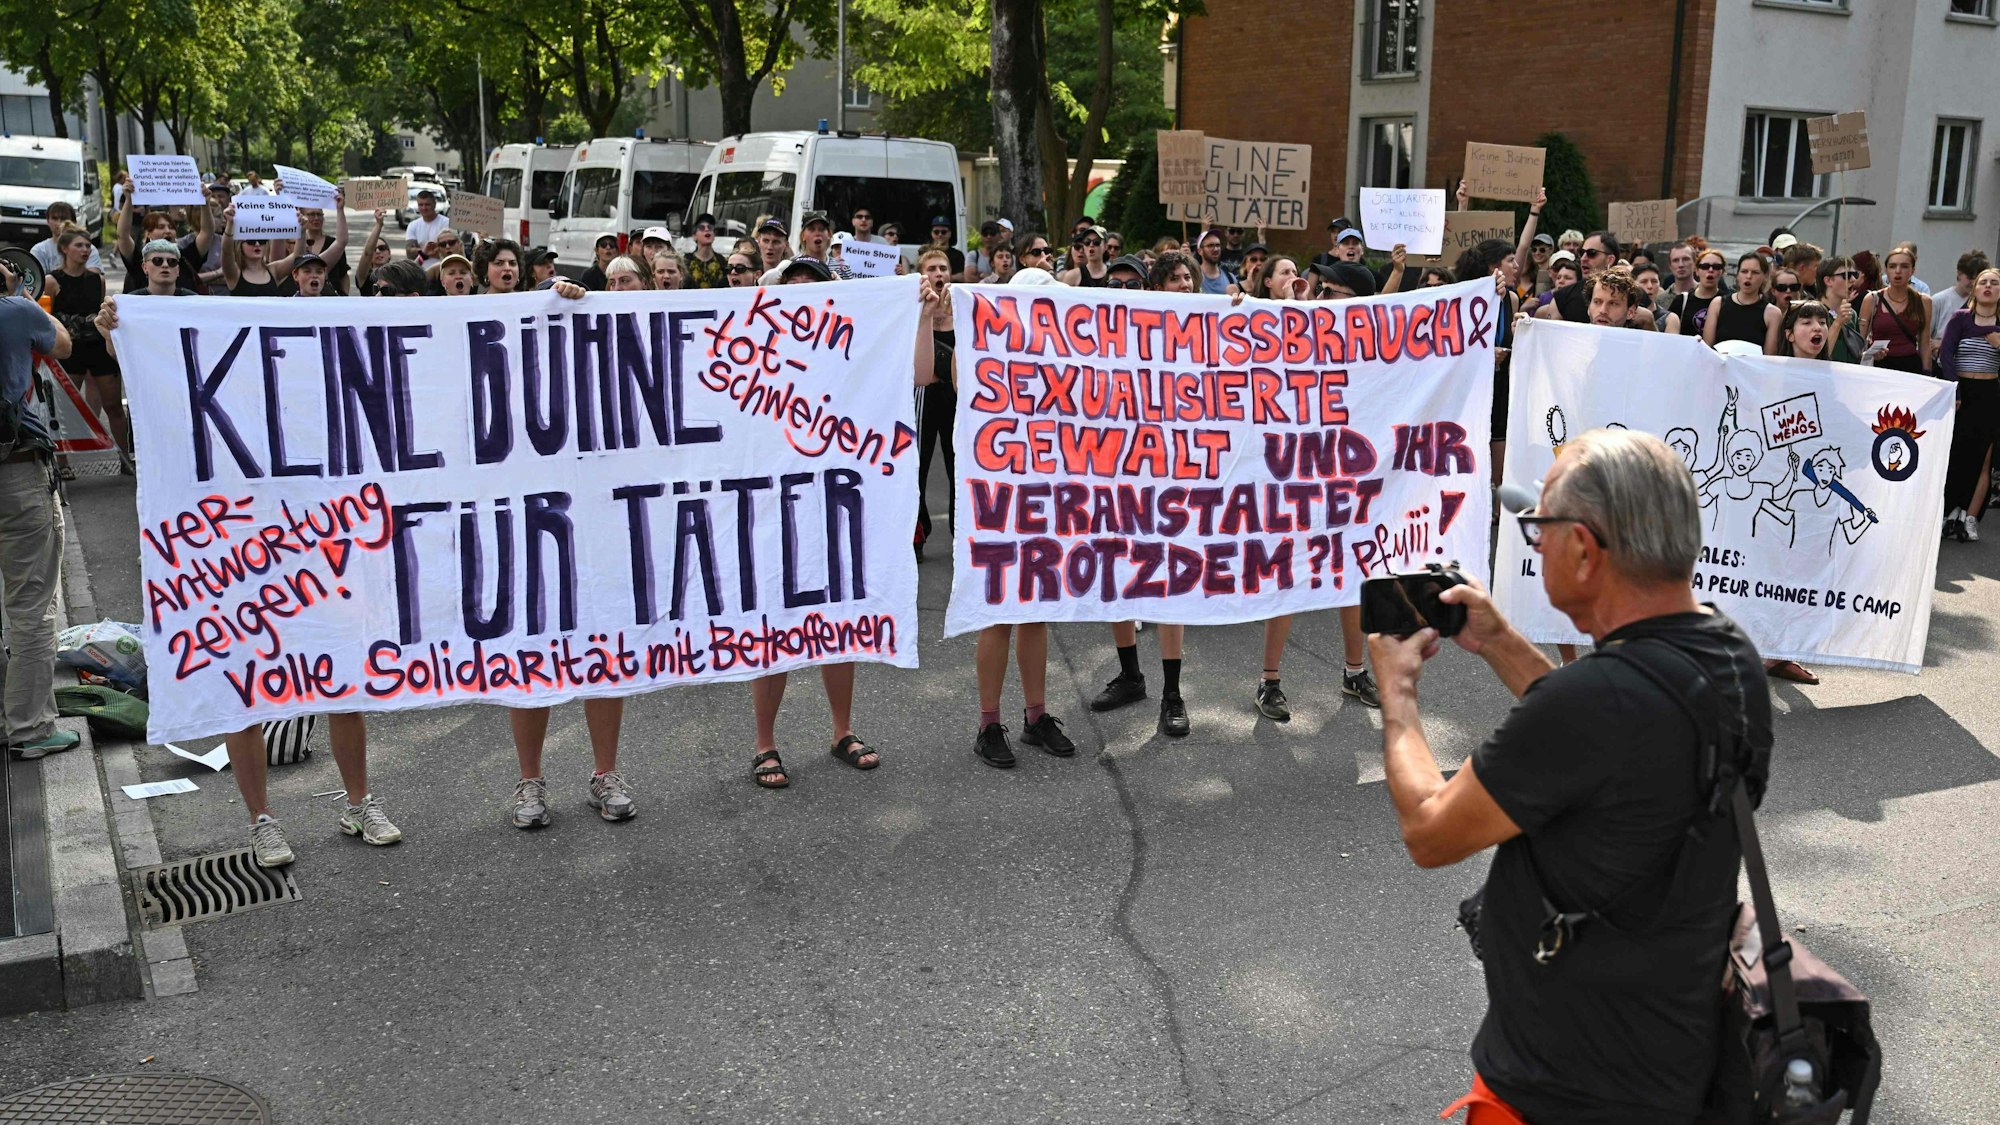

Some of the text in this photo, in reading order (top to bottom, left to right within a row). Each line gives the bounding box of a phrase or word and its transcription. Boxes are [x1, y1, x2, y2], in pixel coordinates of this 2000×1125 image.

[1209, 144, 1297, 174] EINE
[1204, 169, 1290, 197] ÜHNE
[1505, 170, 1518, 178] die
[236, 202, 294, 210] Keine Show
[261, 214, 275, 222] für
[1226, 197, 1304, 228] TÄTER
[1625, 203, 1660, 217] STOP
[239, 226, 297, 234] Lindemann!
[846, 246, 897, 260] Keine Show
[864, 260, 876, 269] für
[745, 287, 855, 361] Kein
[972, 292, 1493, 369] MACHTMISSBRAUCH &
[179, 308, 727, 482] KEINE BÜHNE
[970, 357, 1349, 427] SEXUALISIERTE
[1772, 404, 1787, 421] NI
[1777, 410, 1808, 430] UNA
[1772, 420, 1818, 445] MENOS
[973, 417, 1477, 481] GEWALT UND IHR
[966, 476, 1385, 538] VERANSTALTET
[391, 467, 867, 646] FÜR TÄTER
[1708, 574, 1750, 599] PEUR
[1754, 580, 1819, 608] CHANGE
[1824, 590, 1847, 610] DE
[1852, 594, 1902, 621] CAMP
[646, 625, 707, 680] mit
